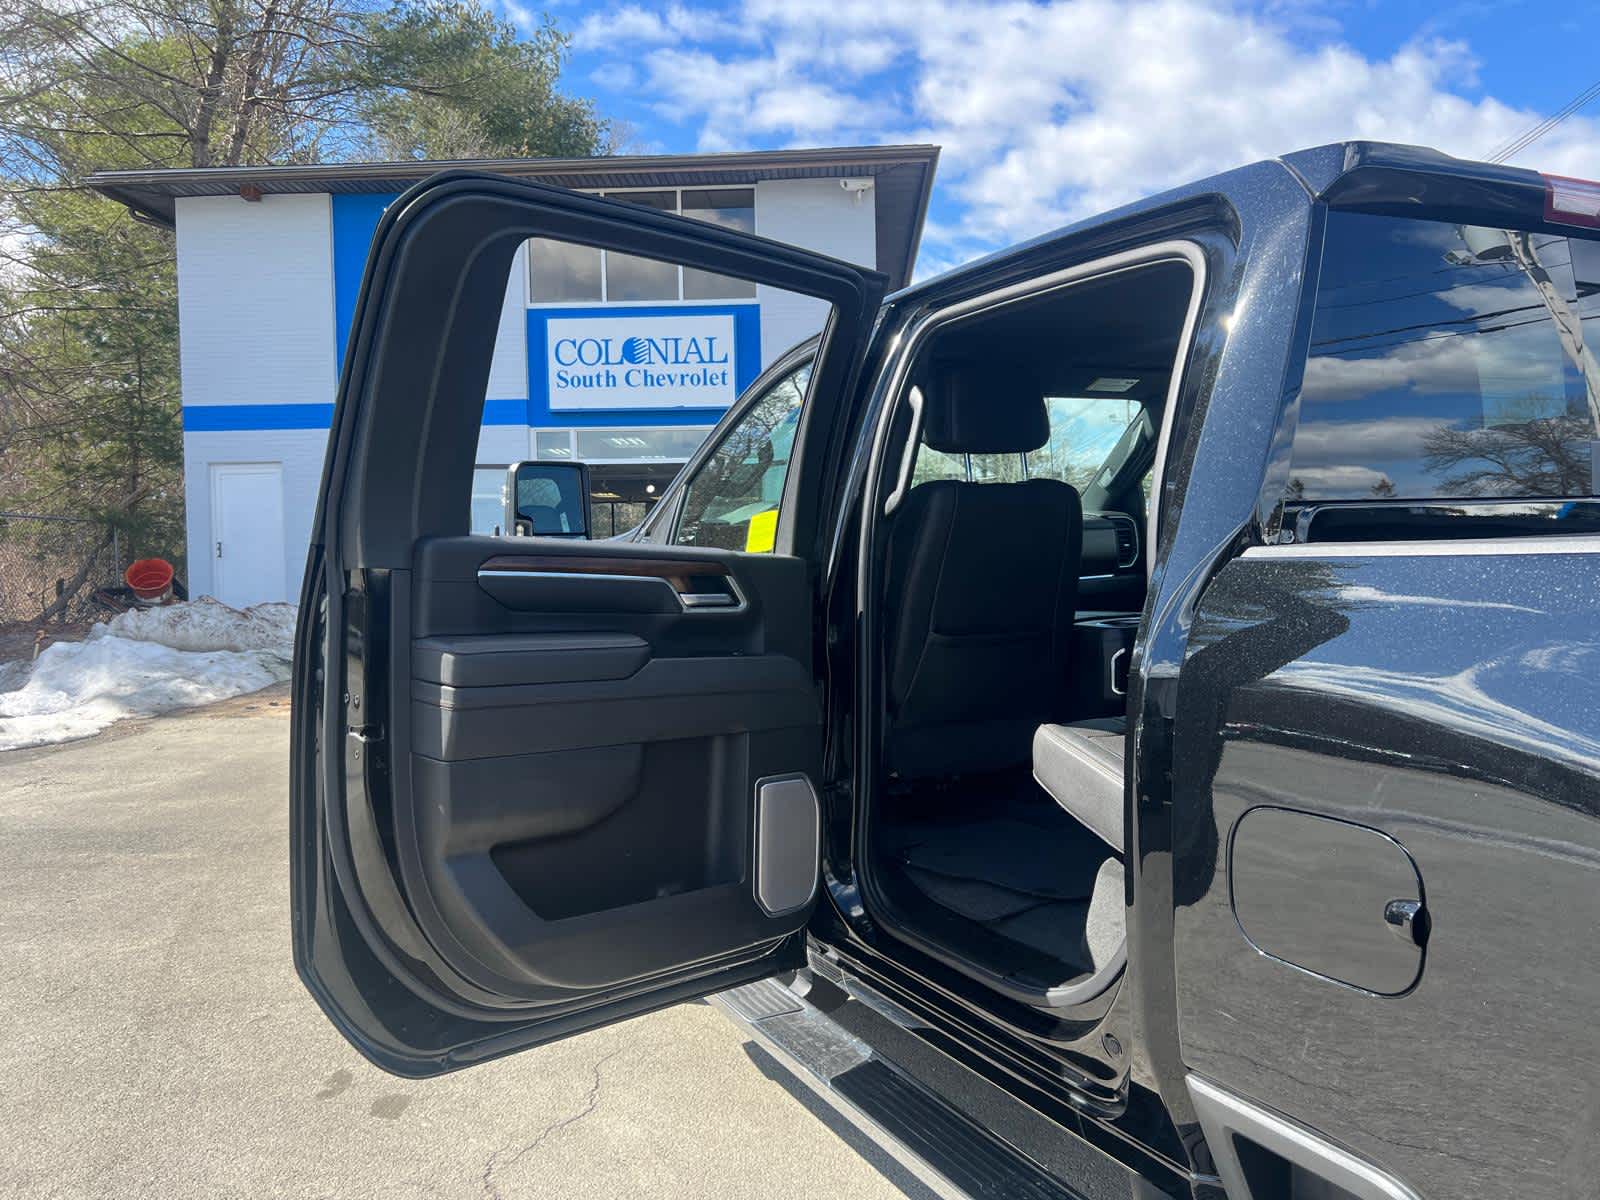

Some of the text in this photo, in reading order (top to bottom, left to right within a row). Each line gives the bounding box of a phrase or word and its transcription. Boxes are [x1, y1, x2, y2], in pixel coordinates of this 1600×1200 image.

[554, 336, 729, 367] COLONIAL
[556, 367, 729, 389] South Chevrolet
